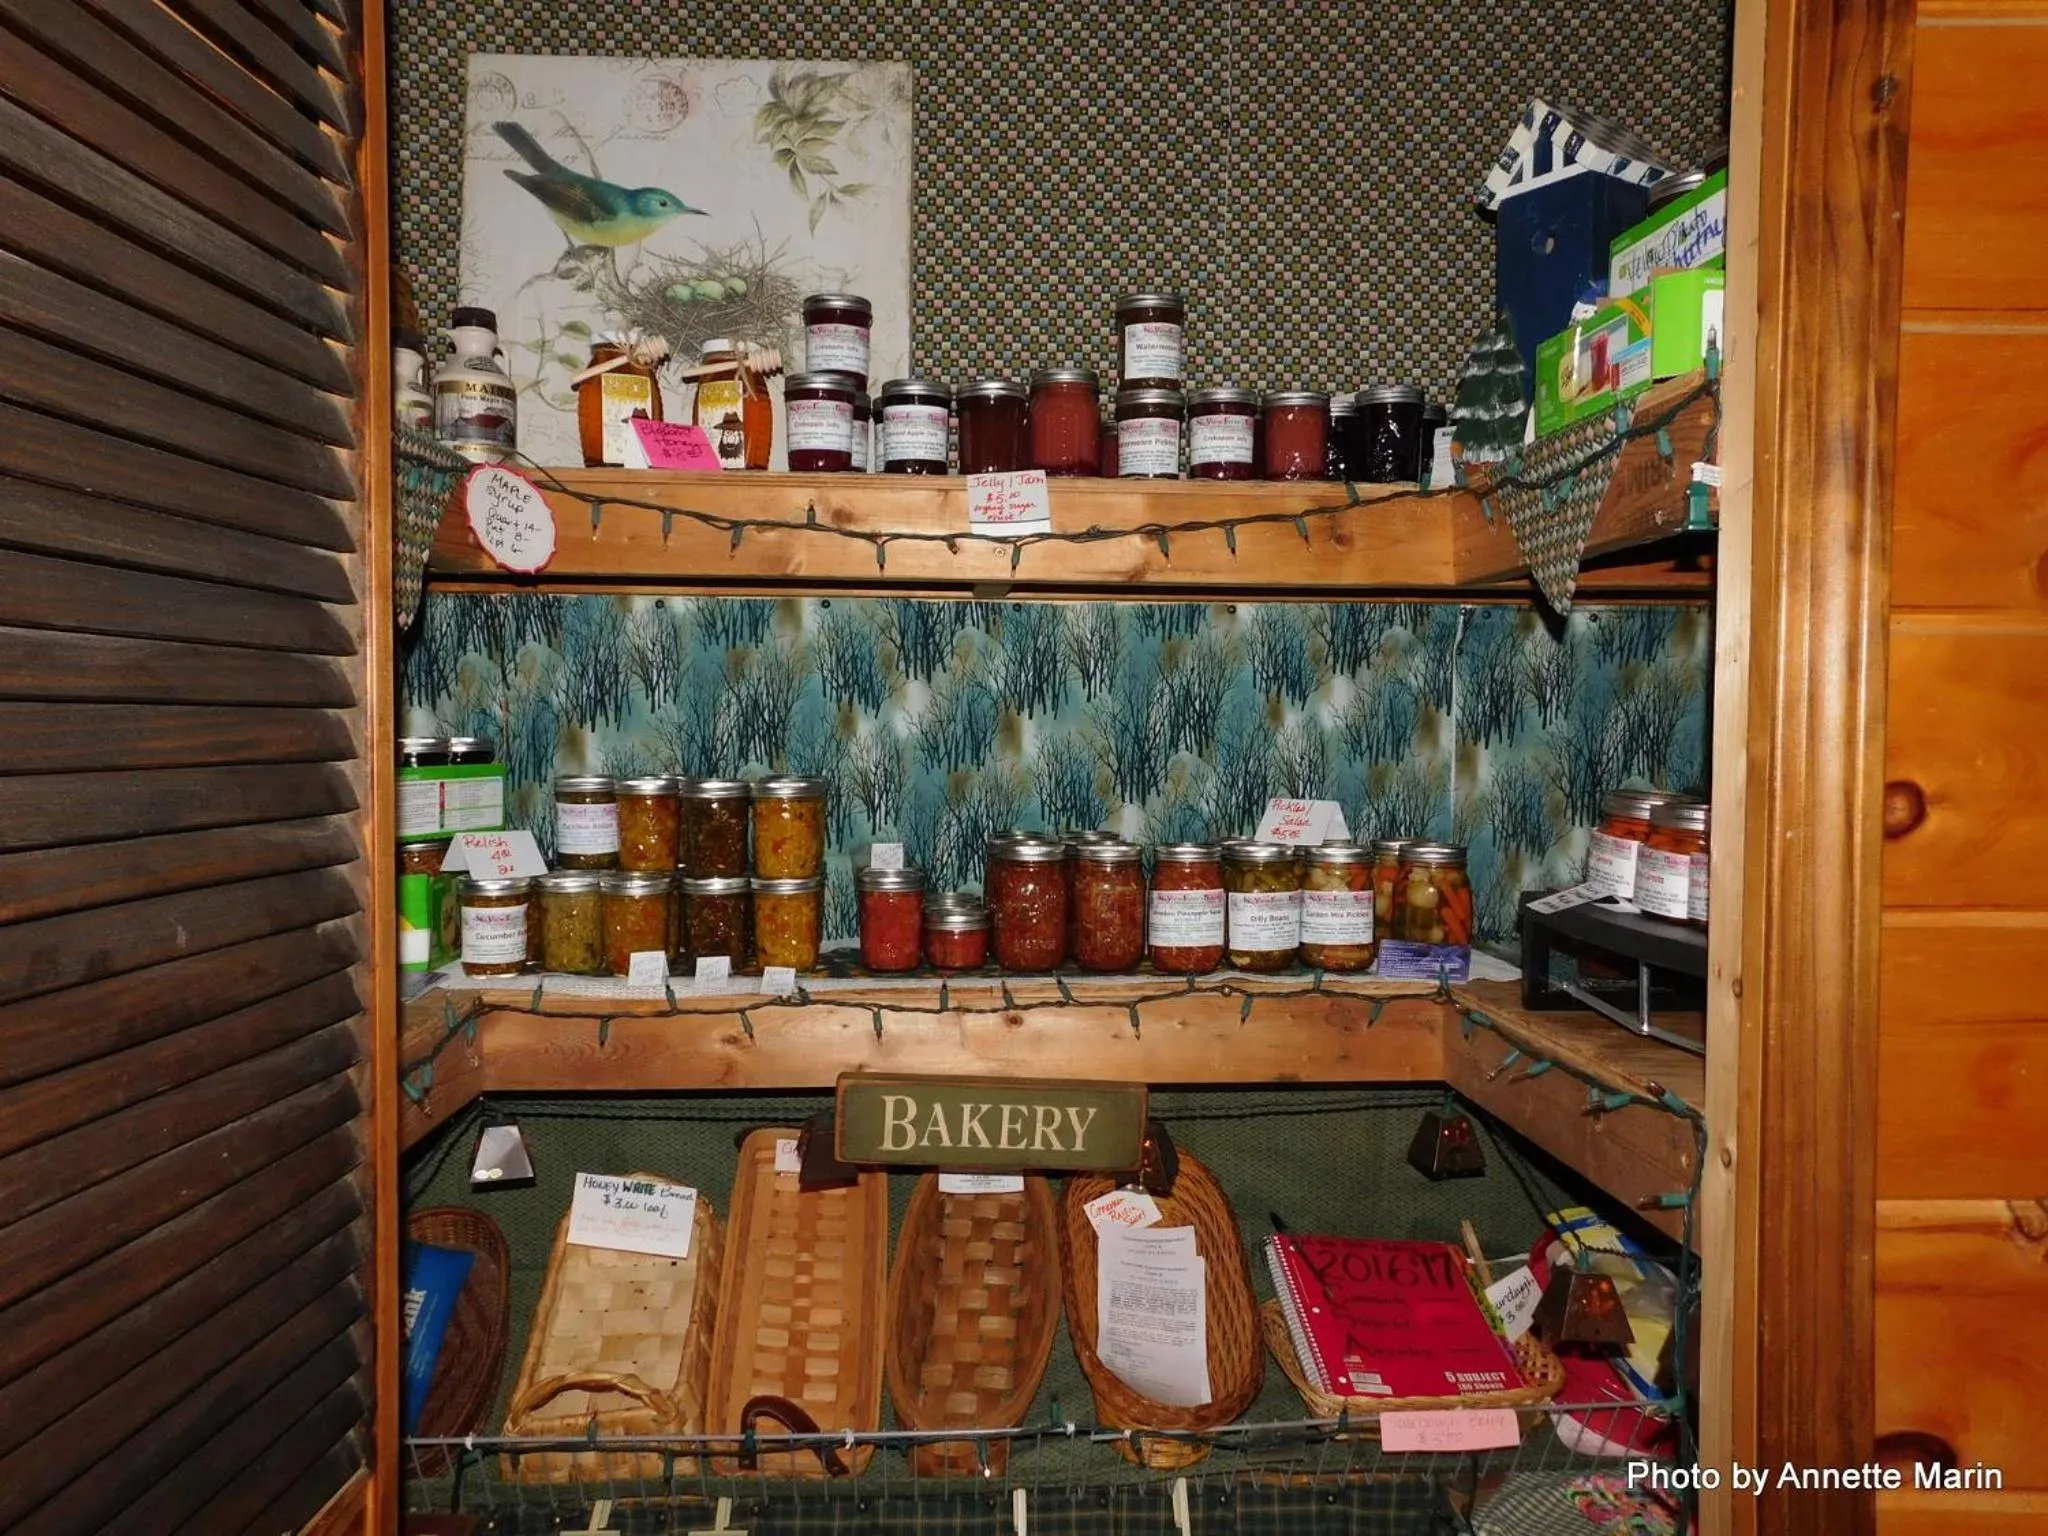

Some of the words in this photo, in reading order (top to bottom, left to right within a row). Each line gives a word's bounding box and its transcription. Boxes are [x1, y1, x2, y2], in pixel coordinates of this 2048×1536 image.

[491, 473, 532, 504] MAPLE
[969, 475, 1005, 494] Jelly
[1015, 473, 1044, 485] Jam
[462, 833, 509, 849] Relish
[1250, 914, 1268, 923] Dilly
[1269, 914, 1290, 923] Beans
[475, 931, 516, 941] Cucumber
[877, 1095, 1098, 1152] BAKERY
[643, 1201, 669, 1220] loaf
[1444, 1371, 1457, 1384] 5
[1456, 1371, 1507, 1382] SUBJECT
